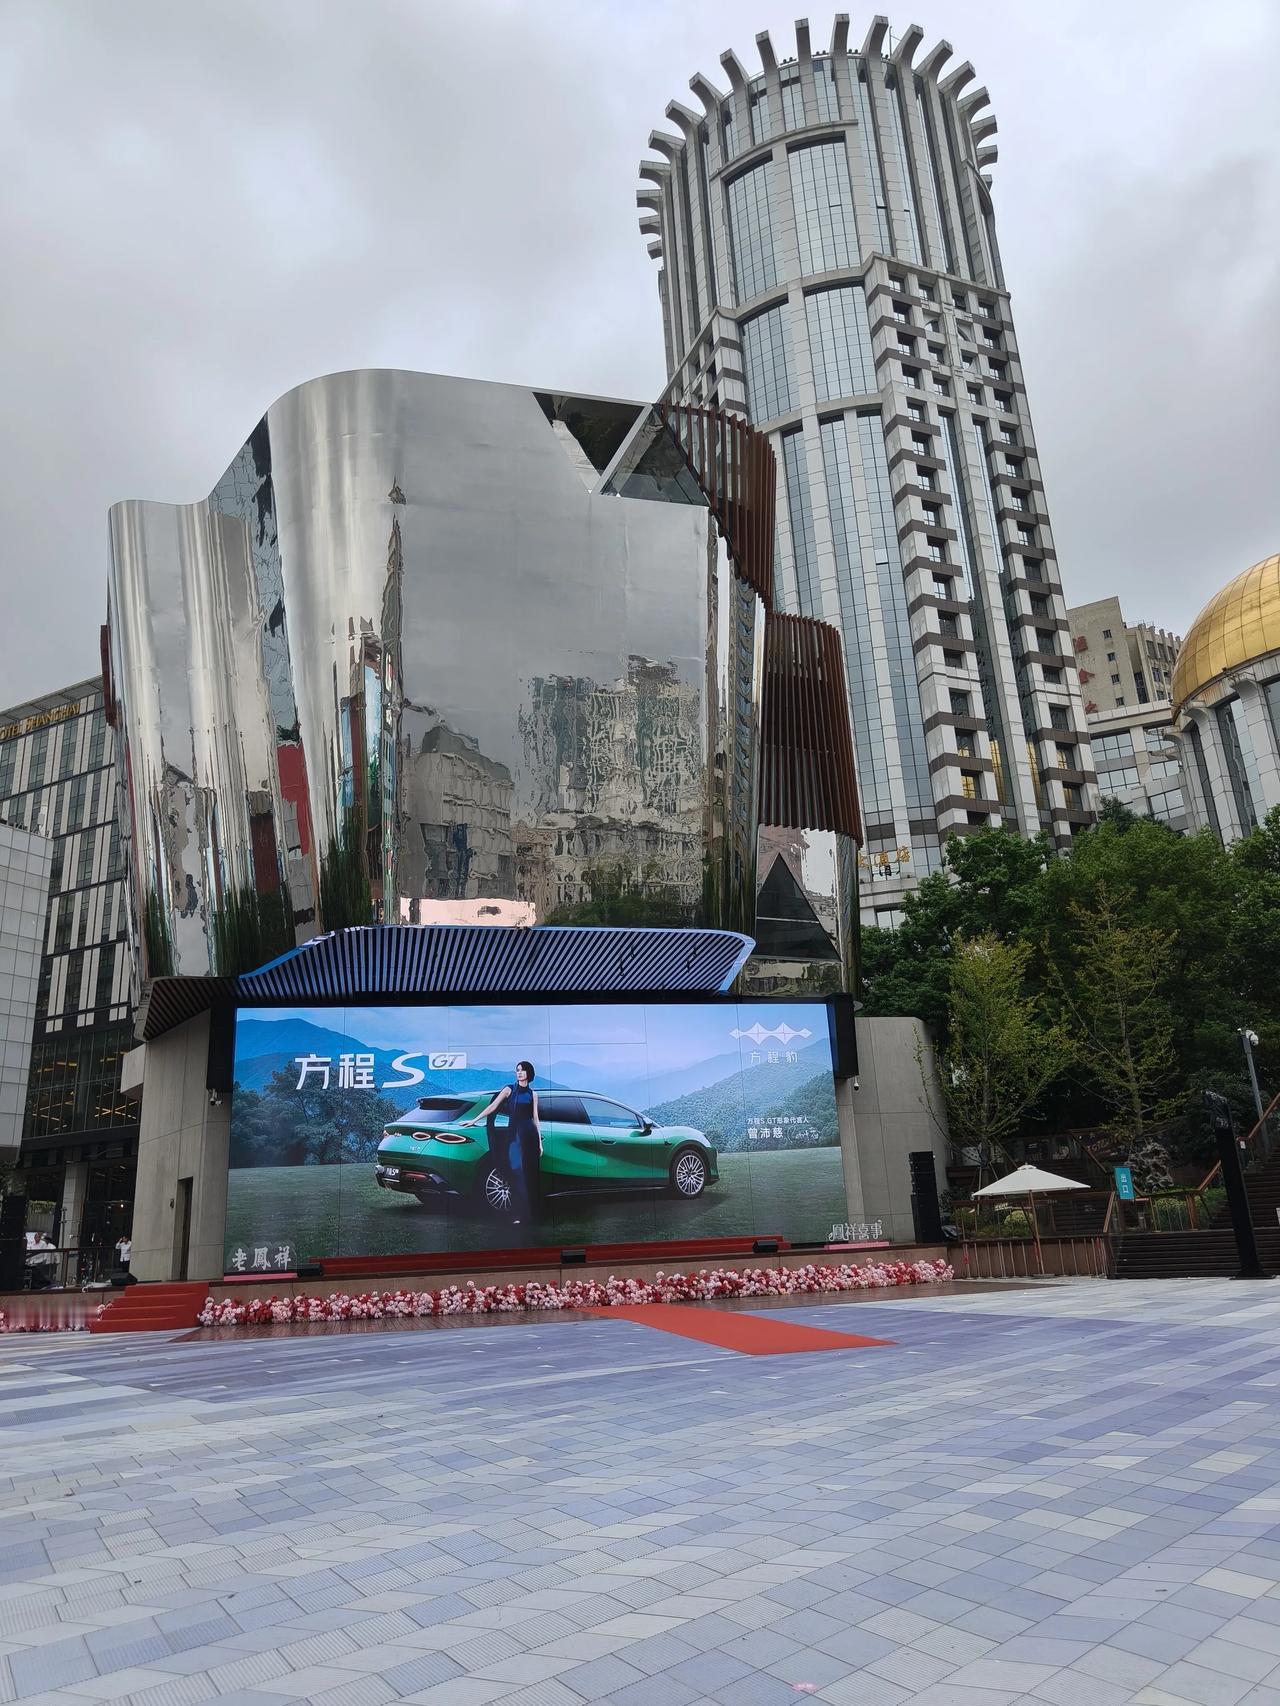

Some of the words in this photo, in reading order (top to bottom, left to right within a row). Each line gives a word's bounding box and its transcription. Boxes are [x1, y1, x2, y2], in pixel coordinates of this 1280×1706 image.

[749, 1050, 798, 1065] 方程豹
[294, 1053, 375, 1090] 方程
[381, 1052, 425, 1089] S
[431, 1053, 465, 1069] GT
[747, 1126, 783, 1139] 曾沛慈
[231, 1245, 292, 1272] 老鳳祥
